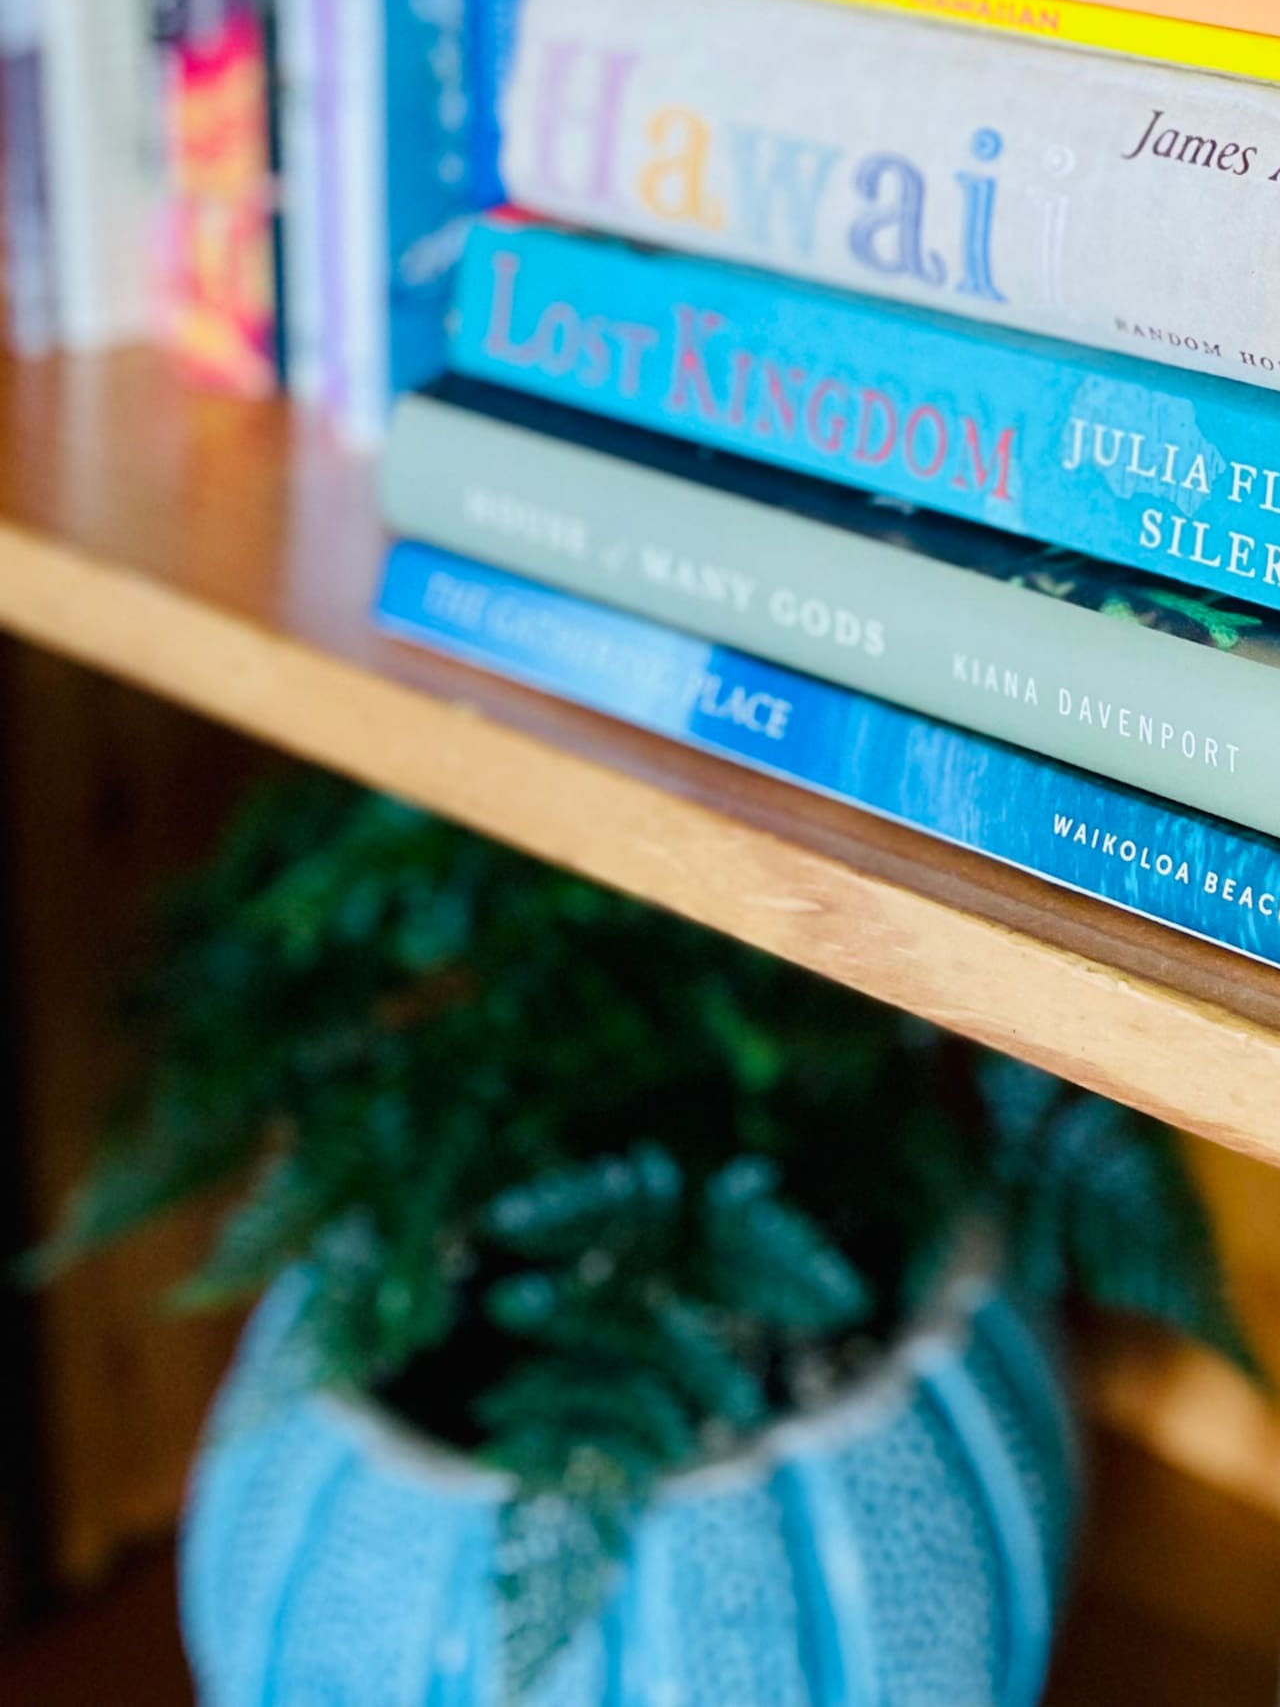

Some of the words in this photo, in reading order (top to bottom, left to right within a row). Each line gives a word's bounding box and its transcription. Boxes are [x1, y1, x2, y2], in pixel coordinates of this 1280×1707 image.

[1120, 109, 1258, 176] James
[1114, 317, 1224, 358] RANDOM
[481, 250, 660, 395] LOST
[665, 302, 1018, 503] KINGDOM
[1062, 418, 1211, 496] JULIA
[638, 543, 759, 615] MANY
[768, 590, 887, 657] GODS
[682, 666, 794, 741] PLACE
[953, 653, 1040, 707] KIANA
[1057, 686, 1242, 774] DAVENPORT
[1052, 813, 1191, 886] WAIKOLOA
